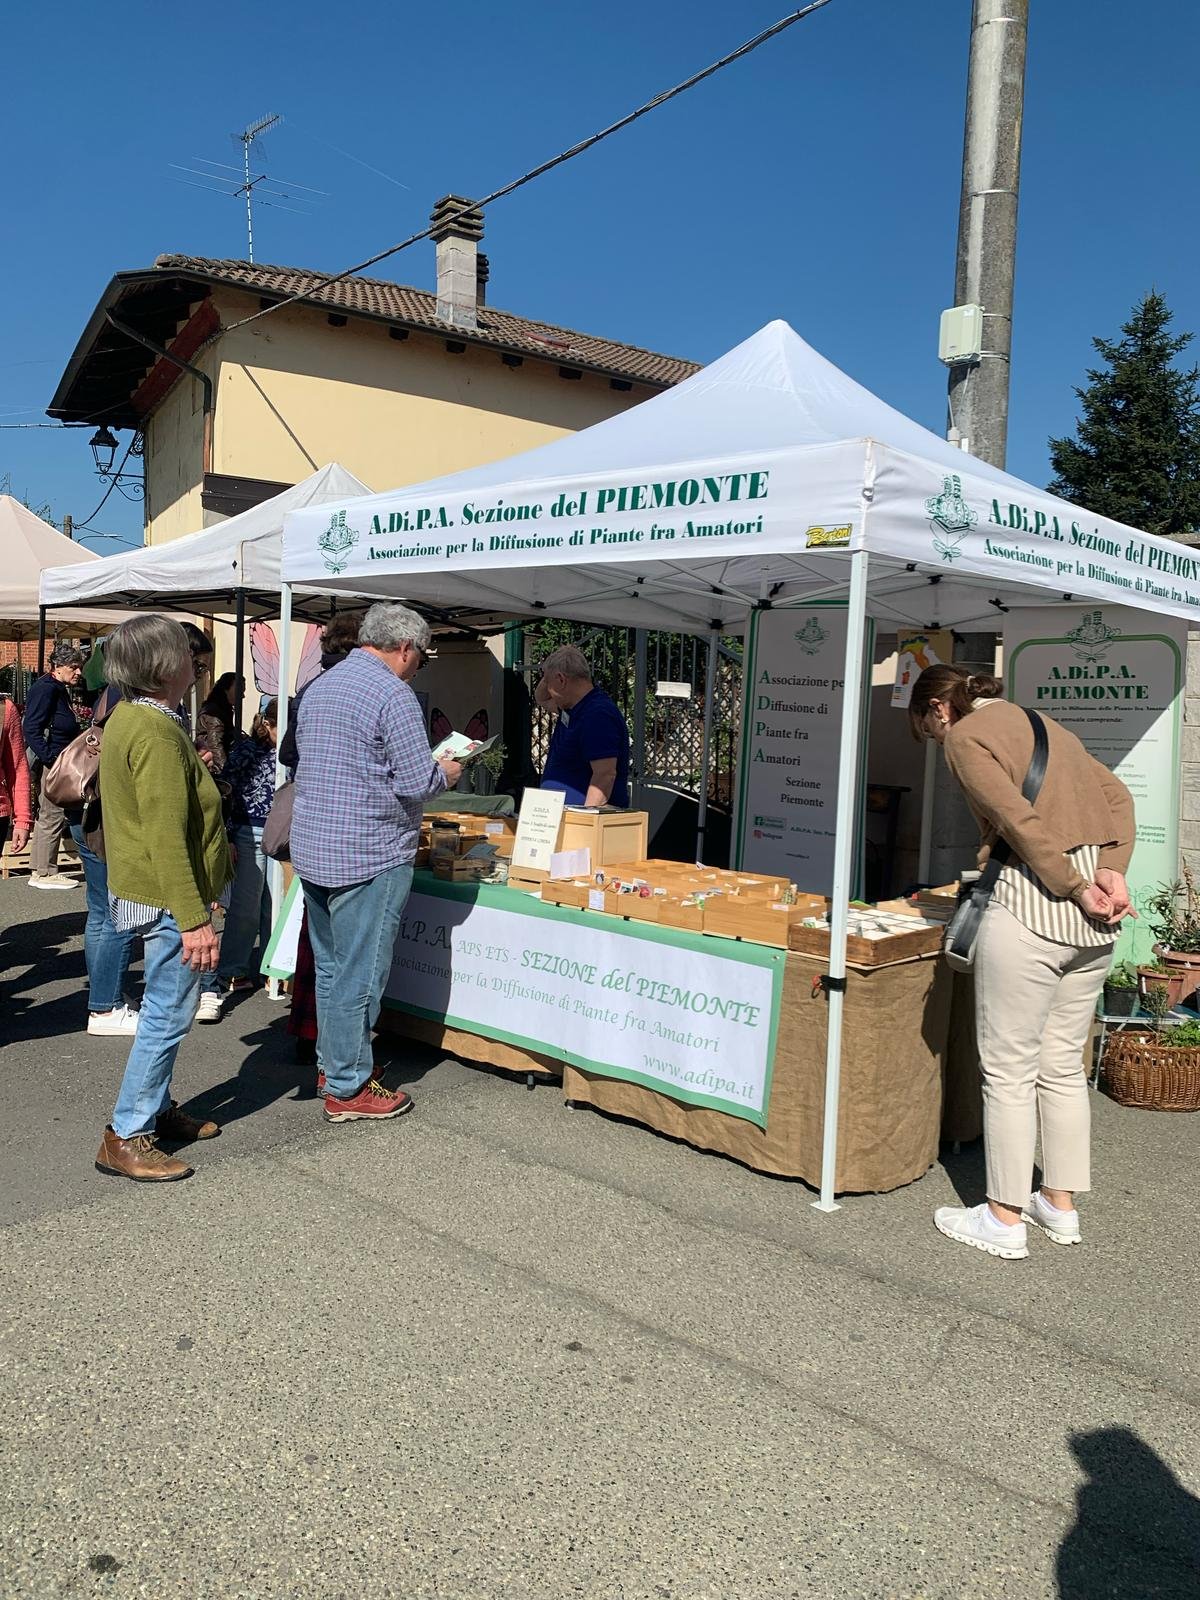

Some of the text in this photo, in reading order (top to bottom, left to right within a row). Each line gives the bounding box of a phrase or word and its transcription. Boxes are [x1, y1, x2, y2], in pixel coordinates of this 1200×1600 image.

[368, 471, 769, 535] A.Di.P.A. Sezione del PIEMONTE
[367, 515, 763, 560] Associazione per la Diffusione di Piante fra Amatori
[988, 499, 1064, 541] A.Di.P.A.
[1068, 521, 1122, 558] Sezione
[1125, 540, 1145, 565] del
[984, 539, 1053, 568] Associazione
[1057, 561, 1073, 575] per
[1076, 560, 1085, 576] la
[1088, 563, 1133, 588] Diffusione
[1135, 577, 1143, 591] di
[1145, 579, 1170, 599] Piante
[1171, 586, 1182, 601] fra
[758, 670, 845, 690] Associazione pe
[1048, 665, 1136, 680] A.Di.P.A.
[1037, 685, 1149, 700] PIEMONTE
[757, 695, 828, 715] Diffusione di
[755, 721, 809, 740] Piante fra
[753, 748, 801, 766] Amatori
[785, 776, 822, 790] Sezione
[780, 793, 824, 808] Piemonte
[456, 940, 482, 957] APS
[485, 946, 509, 963] ETS
[521, 950, 597, 985] SEZIONE
[601, 969, 636, 993] del
[636, 978, 761, 1028] PIEMONTE
[451, 970, 473, 985] per
[476, 972, 488, 988] la
[491, 977, 556, 1006] Diffusione
[559, 993, 571, 1011] di
[573, 999, 619, 1023] Piante
[620, 1011, 647, 1031] fra
[650, 1021, 721, 1053] Amatori
[643, 1055, 755, 1100] www.adipa.it
